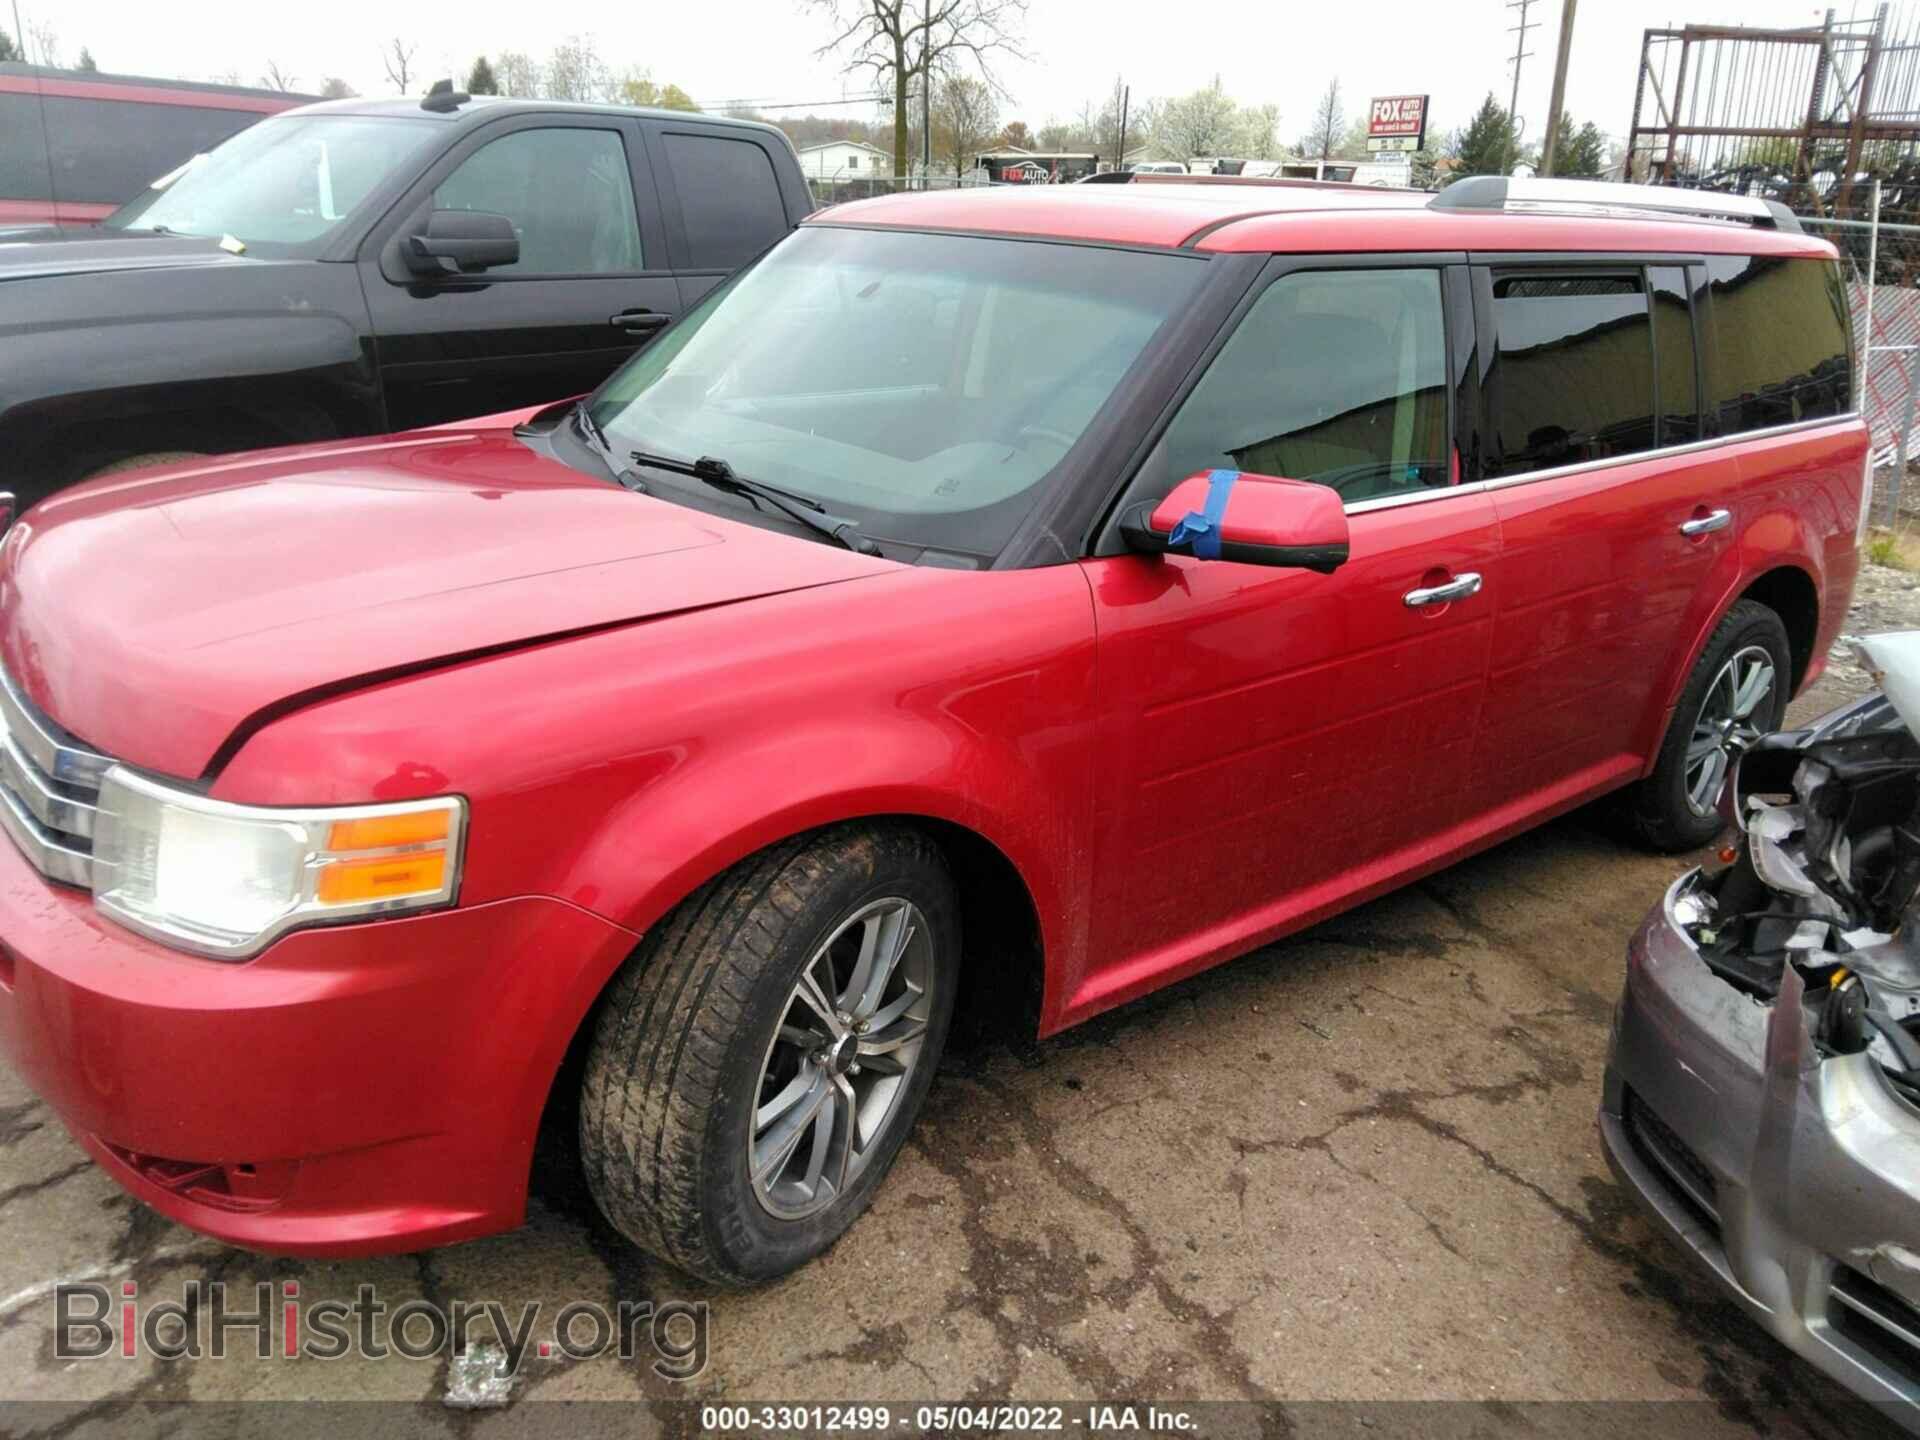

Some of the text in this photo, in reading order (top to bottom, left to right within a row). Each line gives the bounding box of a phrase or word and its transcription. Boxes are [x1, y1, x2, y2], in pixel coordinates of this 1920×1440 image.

[1402, 99, 1420, 110] AUTO
[1372, 101, 1402, 122] FOX
[1002, 168, 1049, 181] FOX AUTO
